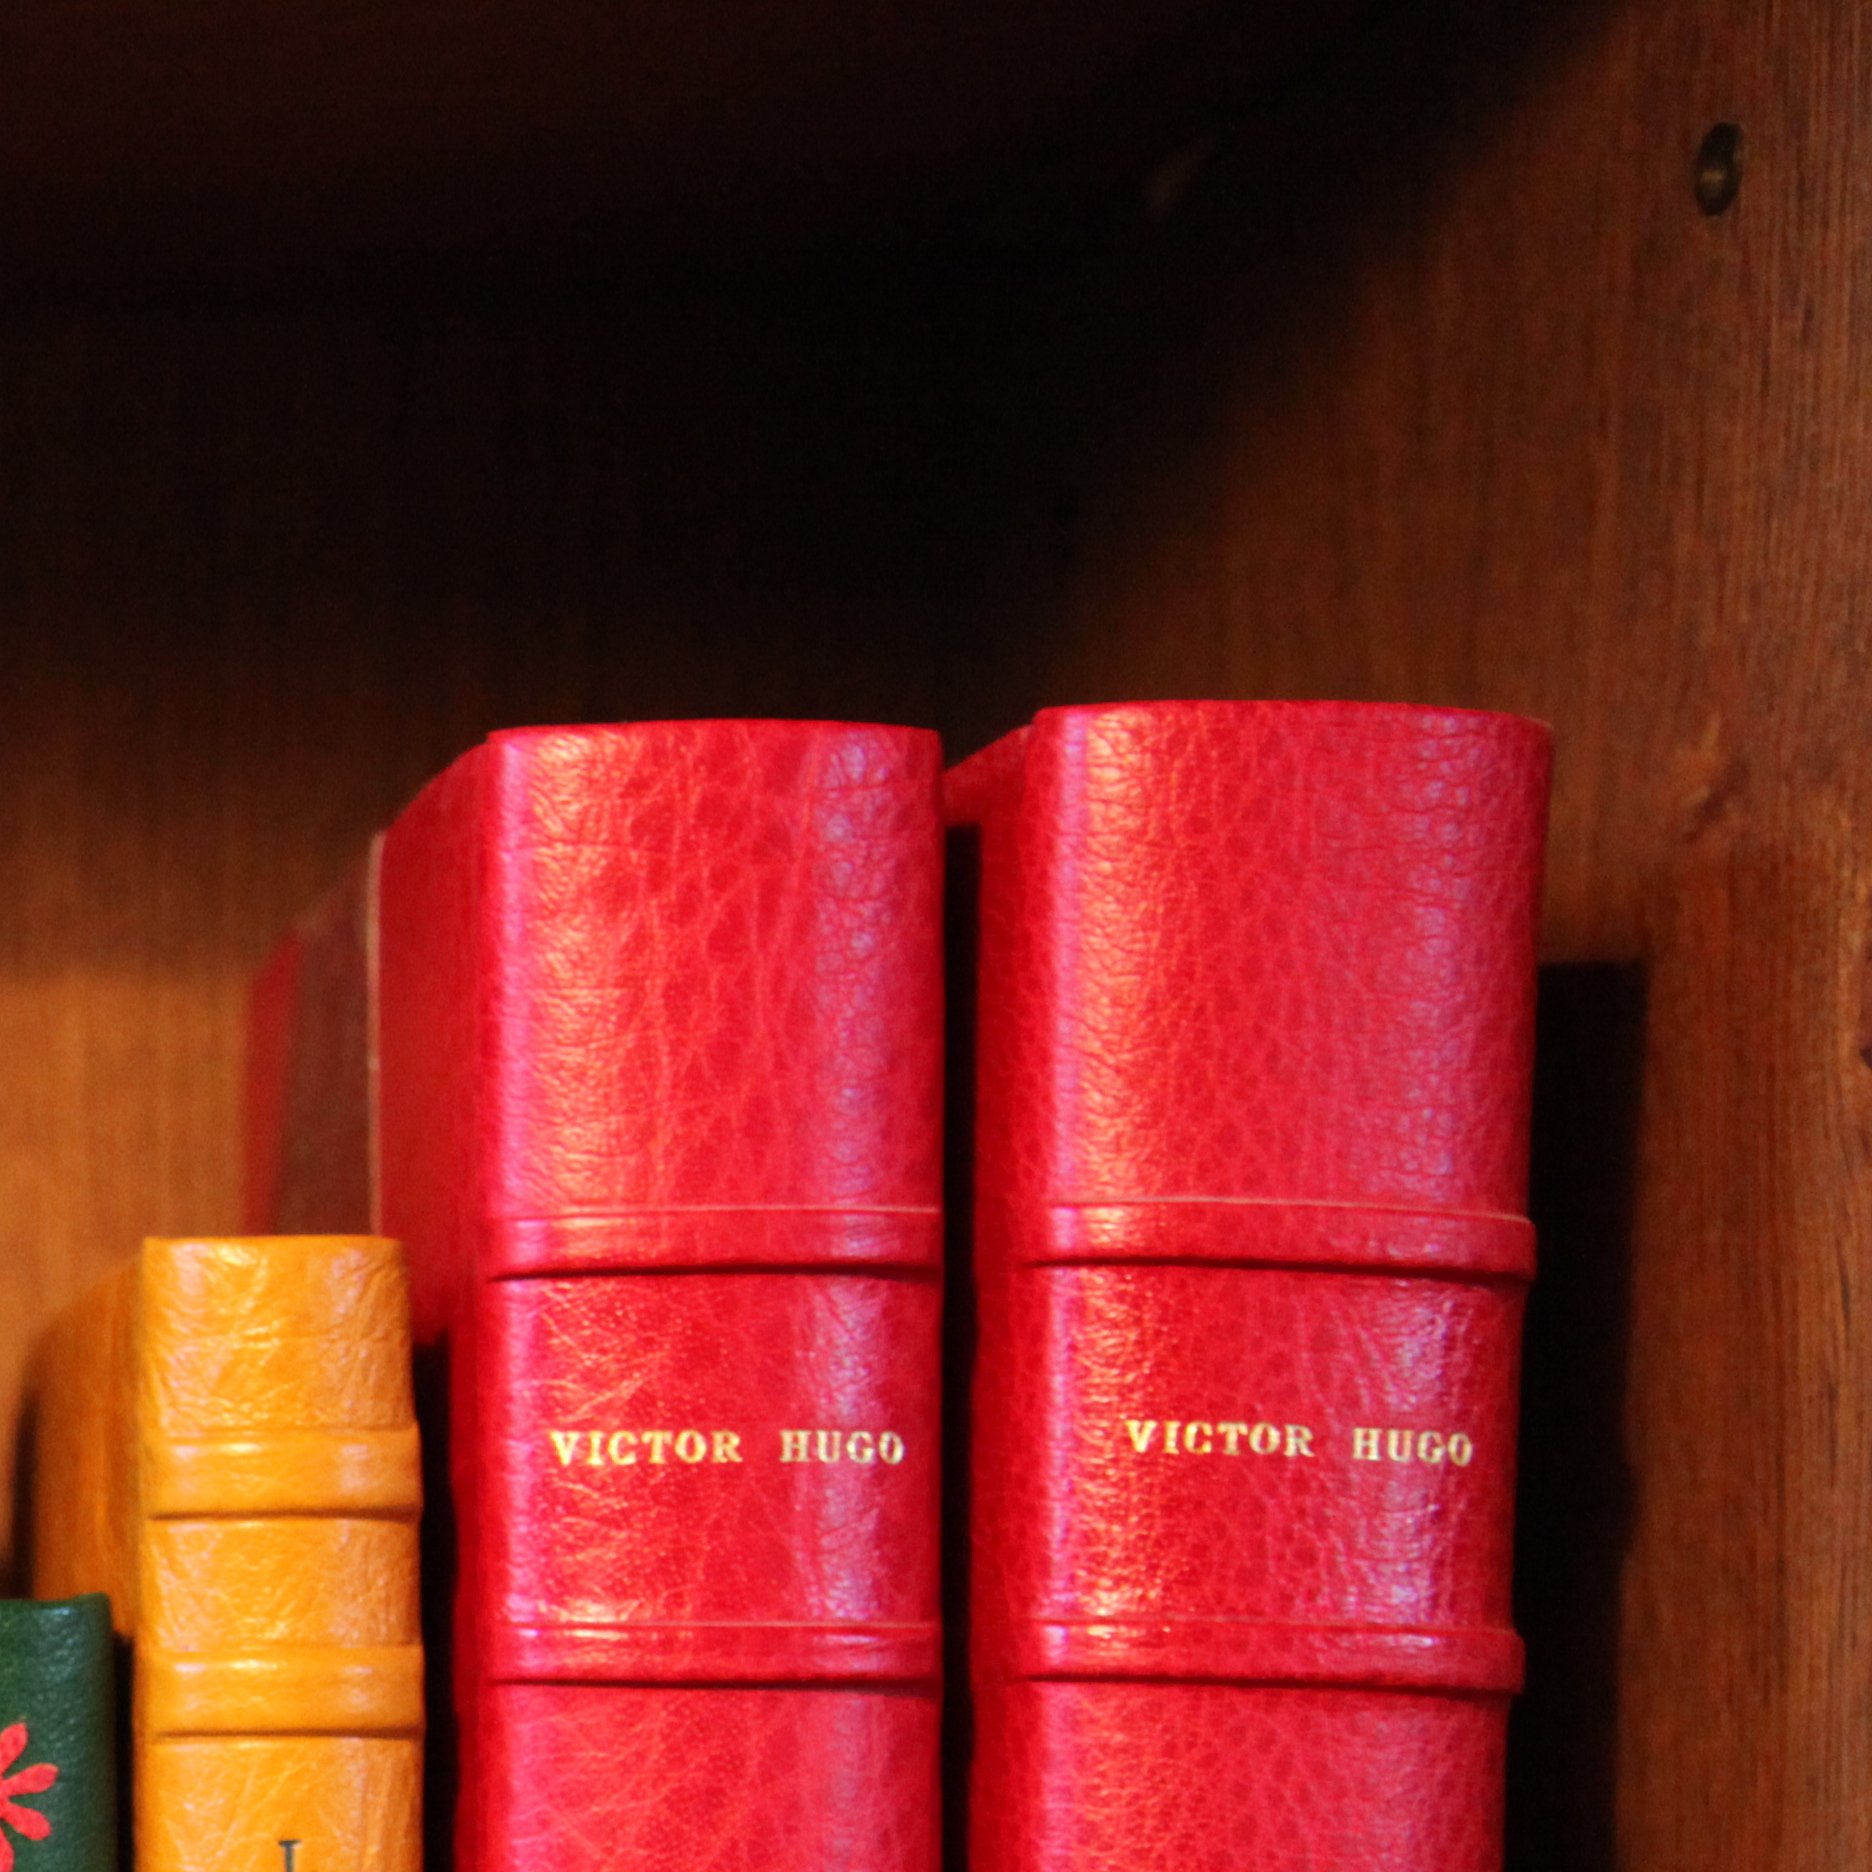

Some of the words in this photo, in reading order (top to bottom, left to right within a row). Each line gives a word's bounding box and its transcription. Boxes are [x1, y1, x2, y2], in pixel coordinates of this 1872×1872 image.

[550, 1428, 743, 1467] VICTOR
[778, 1428, 906, 1467] HUGO
[1124, 1418, 1314, 1459] VICTOR
[1351, 1426, 1474, 1468] HUGO
